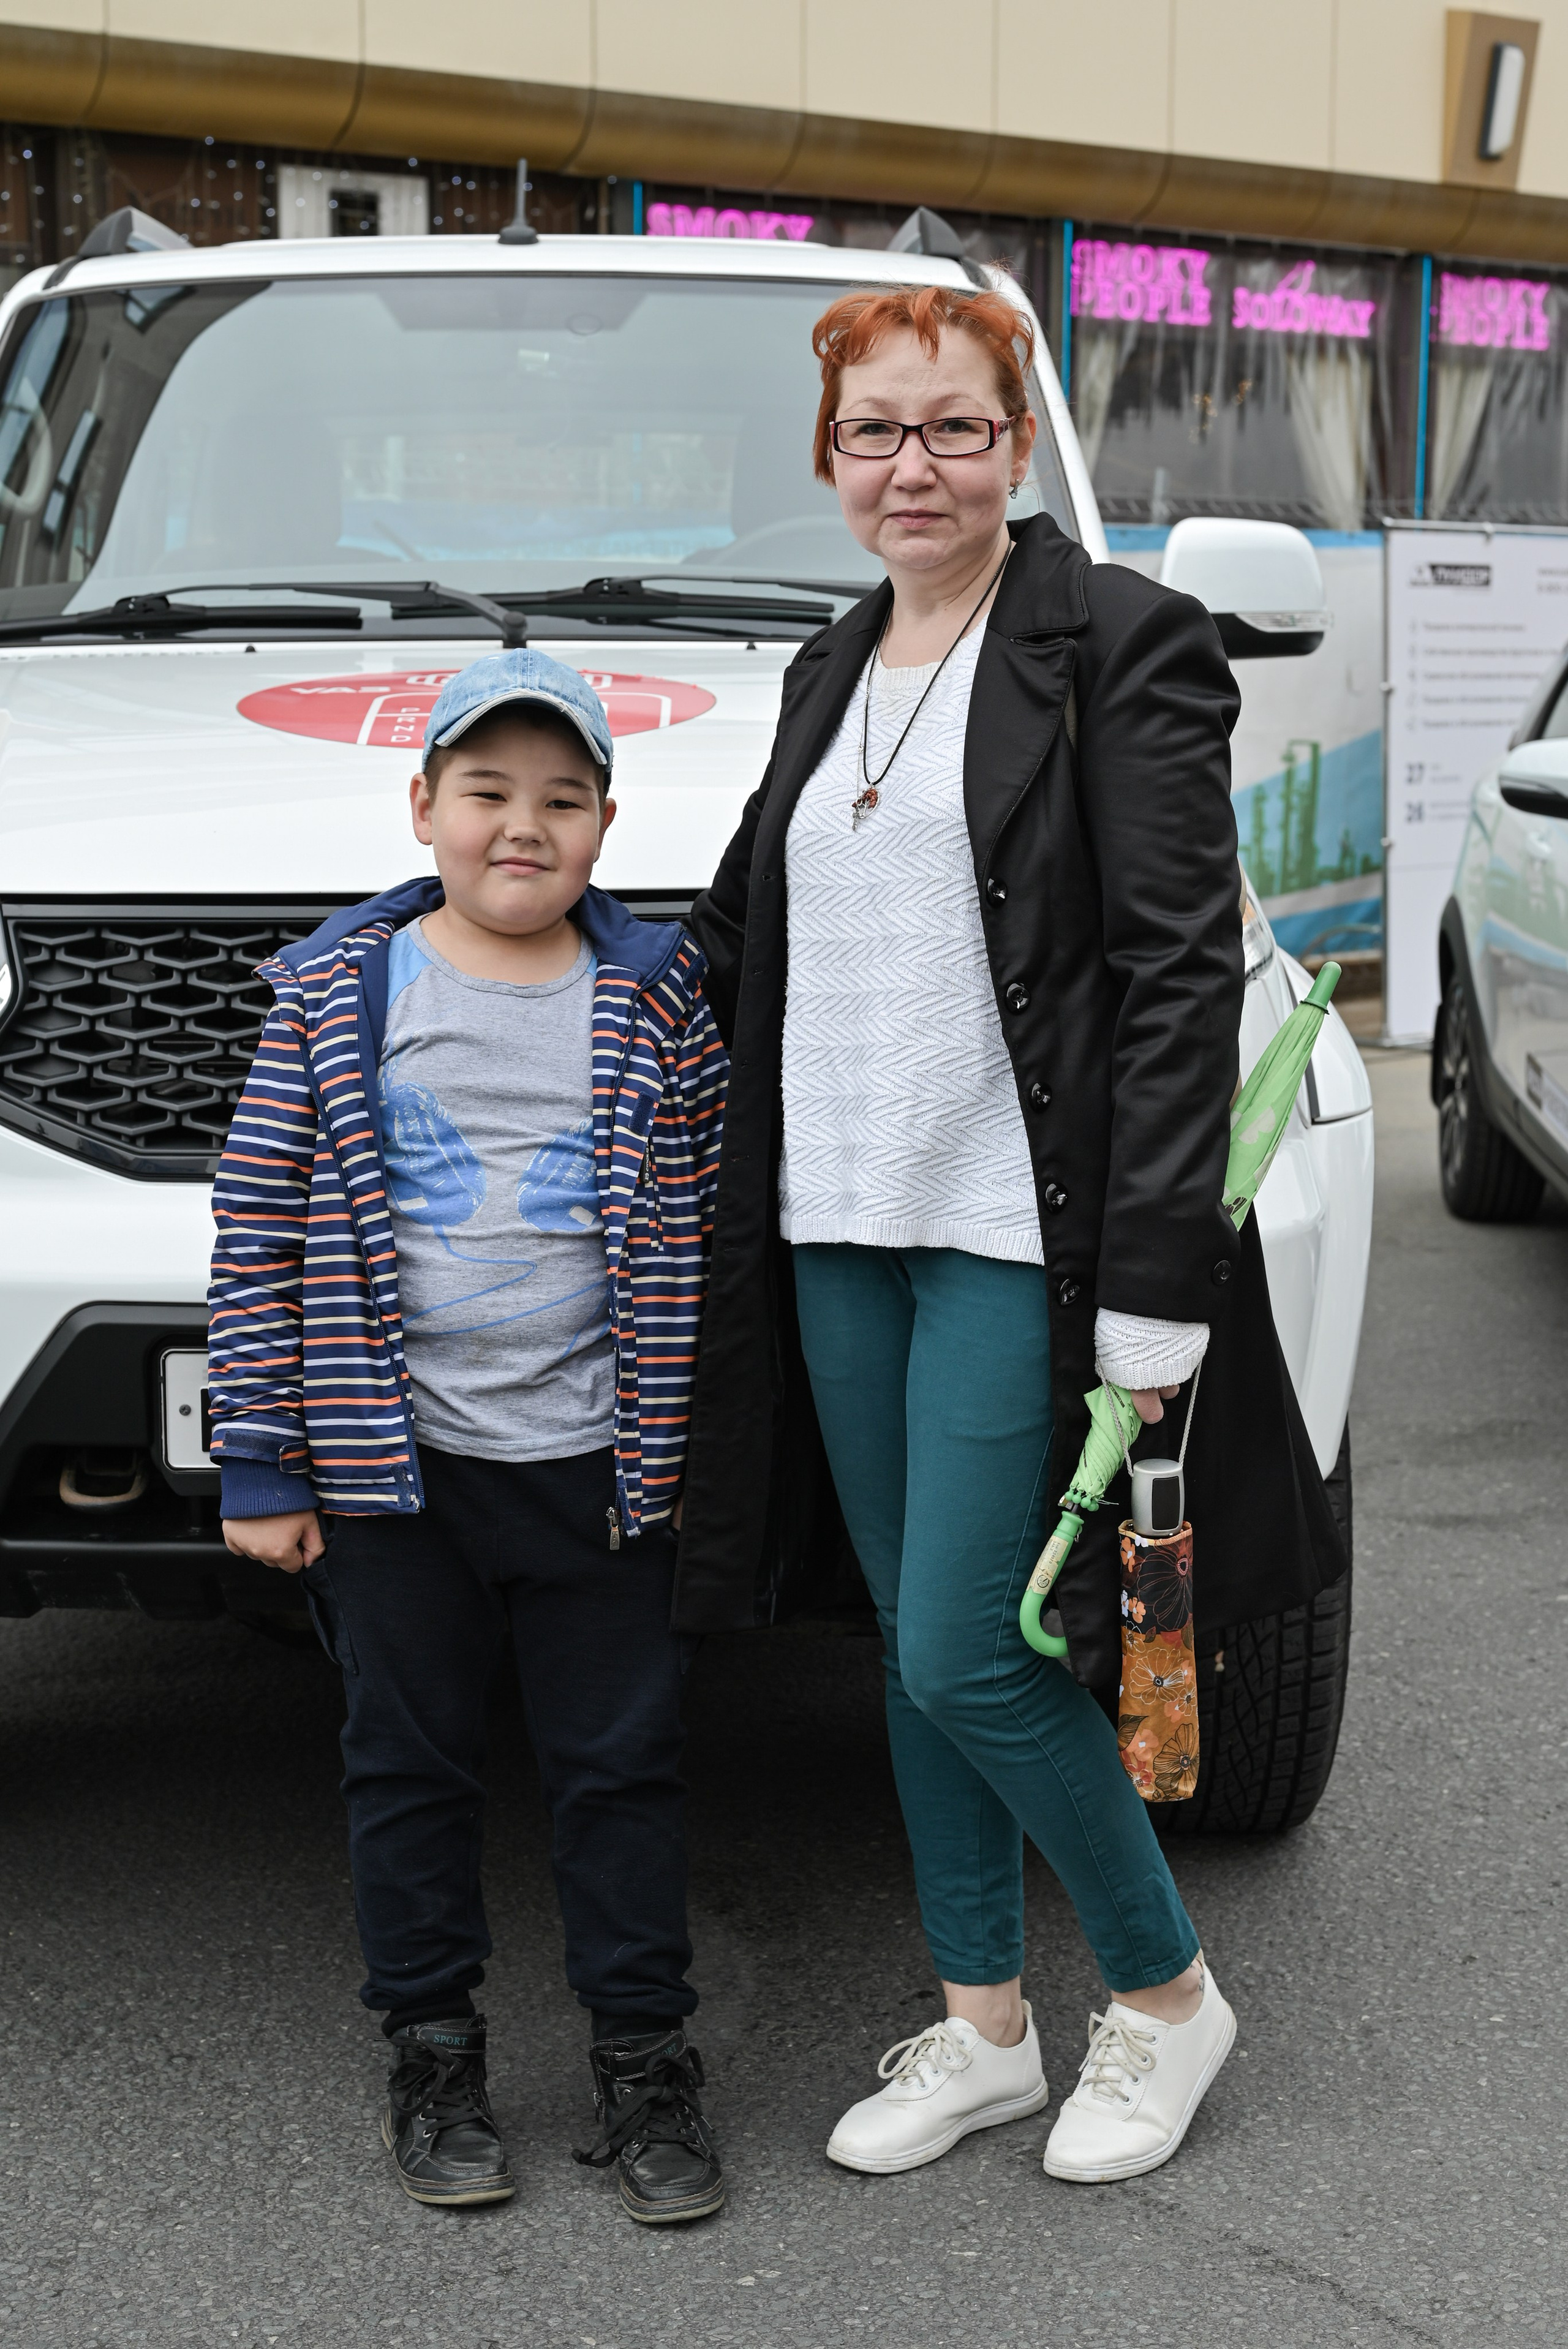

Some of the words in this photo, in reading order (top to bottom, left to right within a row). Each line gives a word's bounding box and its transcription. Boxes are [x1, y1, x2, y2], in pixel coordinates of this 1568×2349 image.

[647, 203, 814, 241] SMOKY
[1072, 239, 1210, 288] SMOKY
[1071, 279, 1212, 326] PEOPLE
[434, 2034, 468, 2046] SPORT
[662, 2043, 677, 2056] ORT
